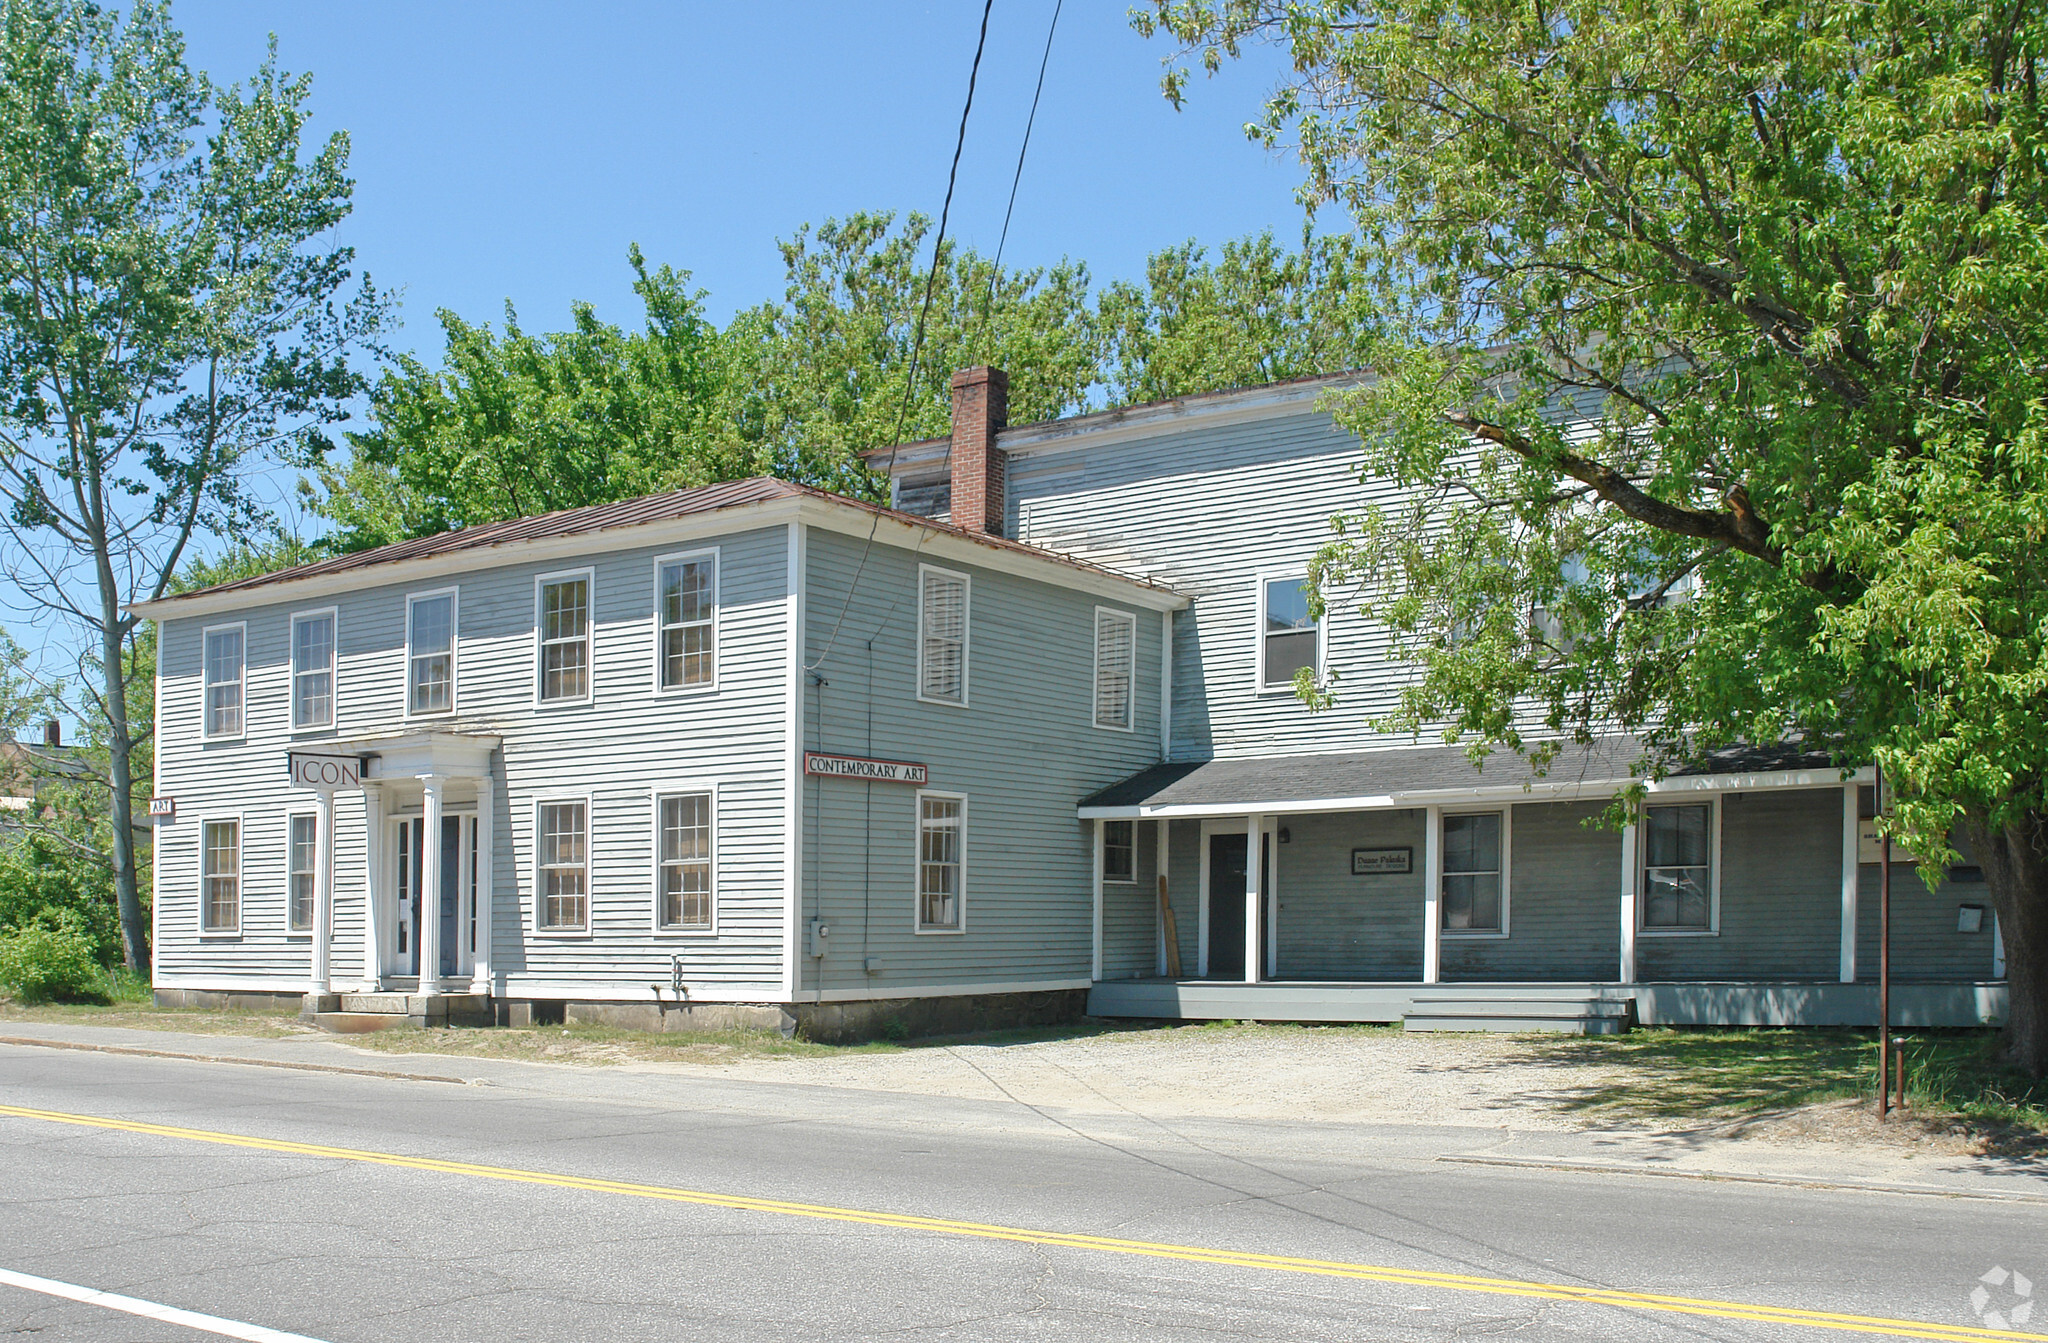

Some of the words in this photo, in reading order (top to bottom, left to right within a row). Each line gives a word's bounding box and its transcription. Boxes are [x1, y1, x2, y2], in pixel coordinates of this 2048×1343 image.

[295, 760, 359, 785] ICON
[809, 757, 898, 779] CONTEMPORARY
[904, 767, 924, 781] ART
[152, 800, 169, 812] ART
